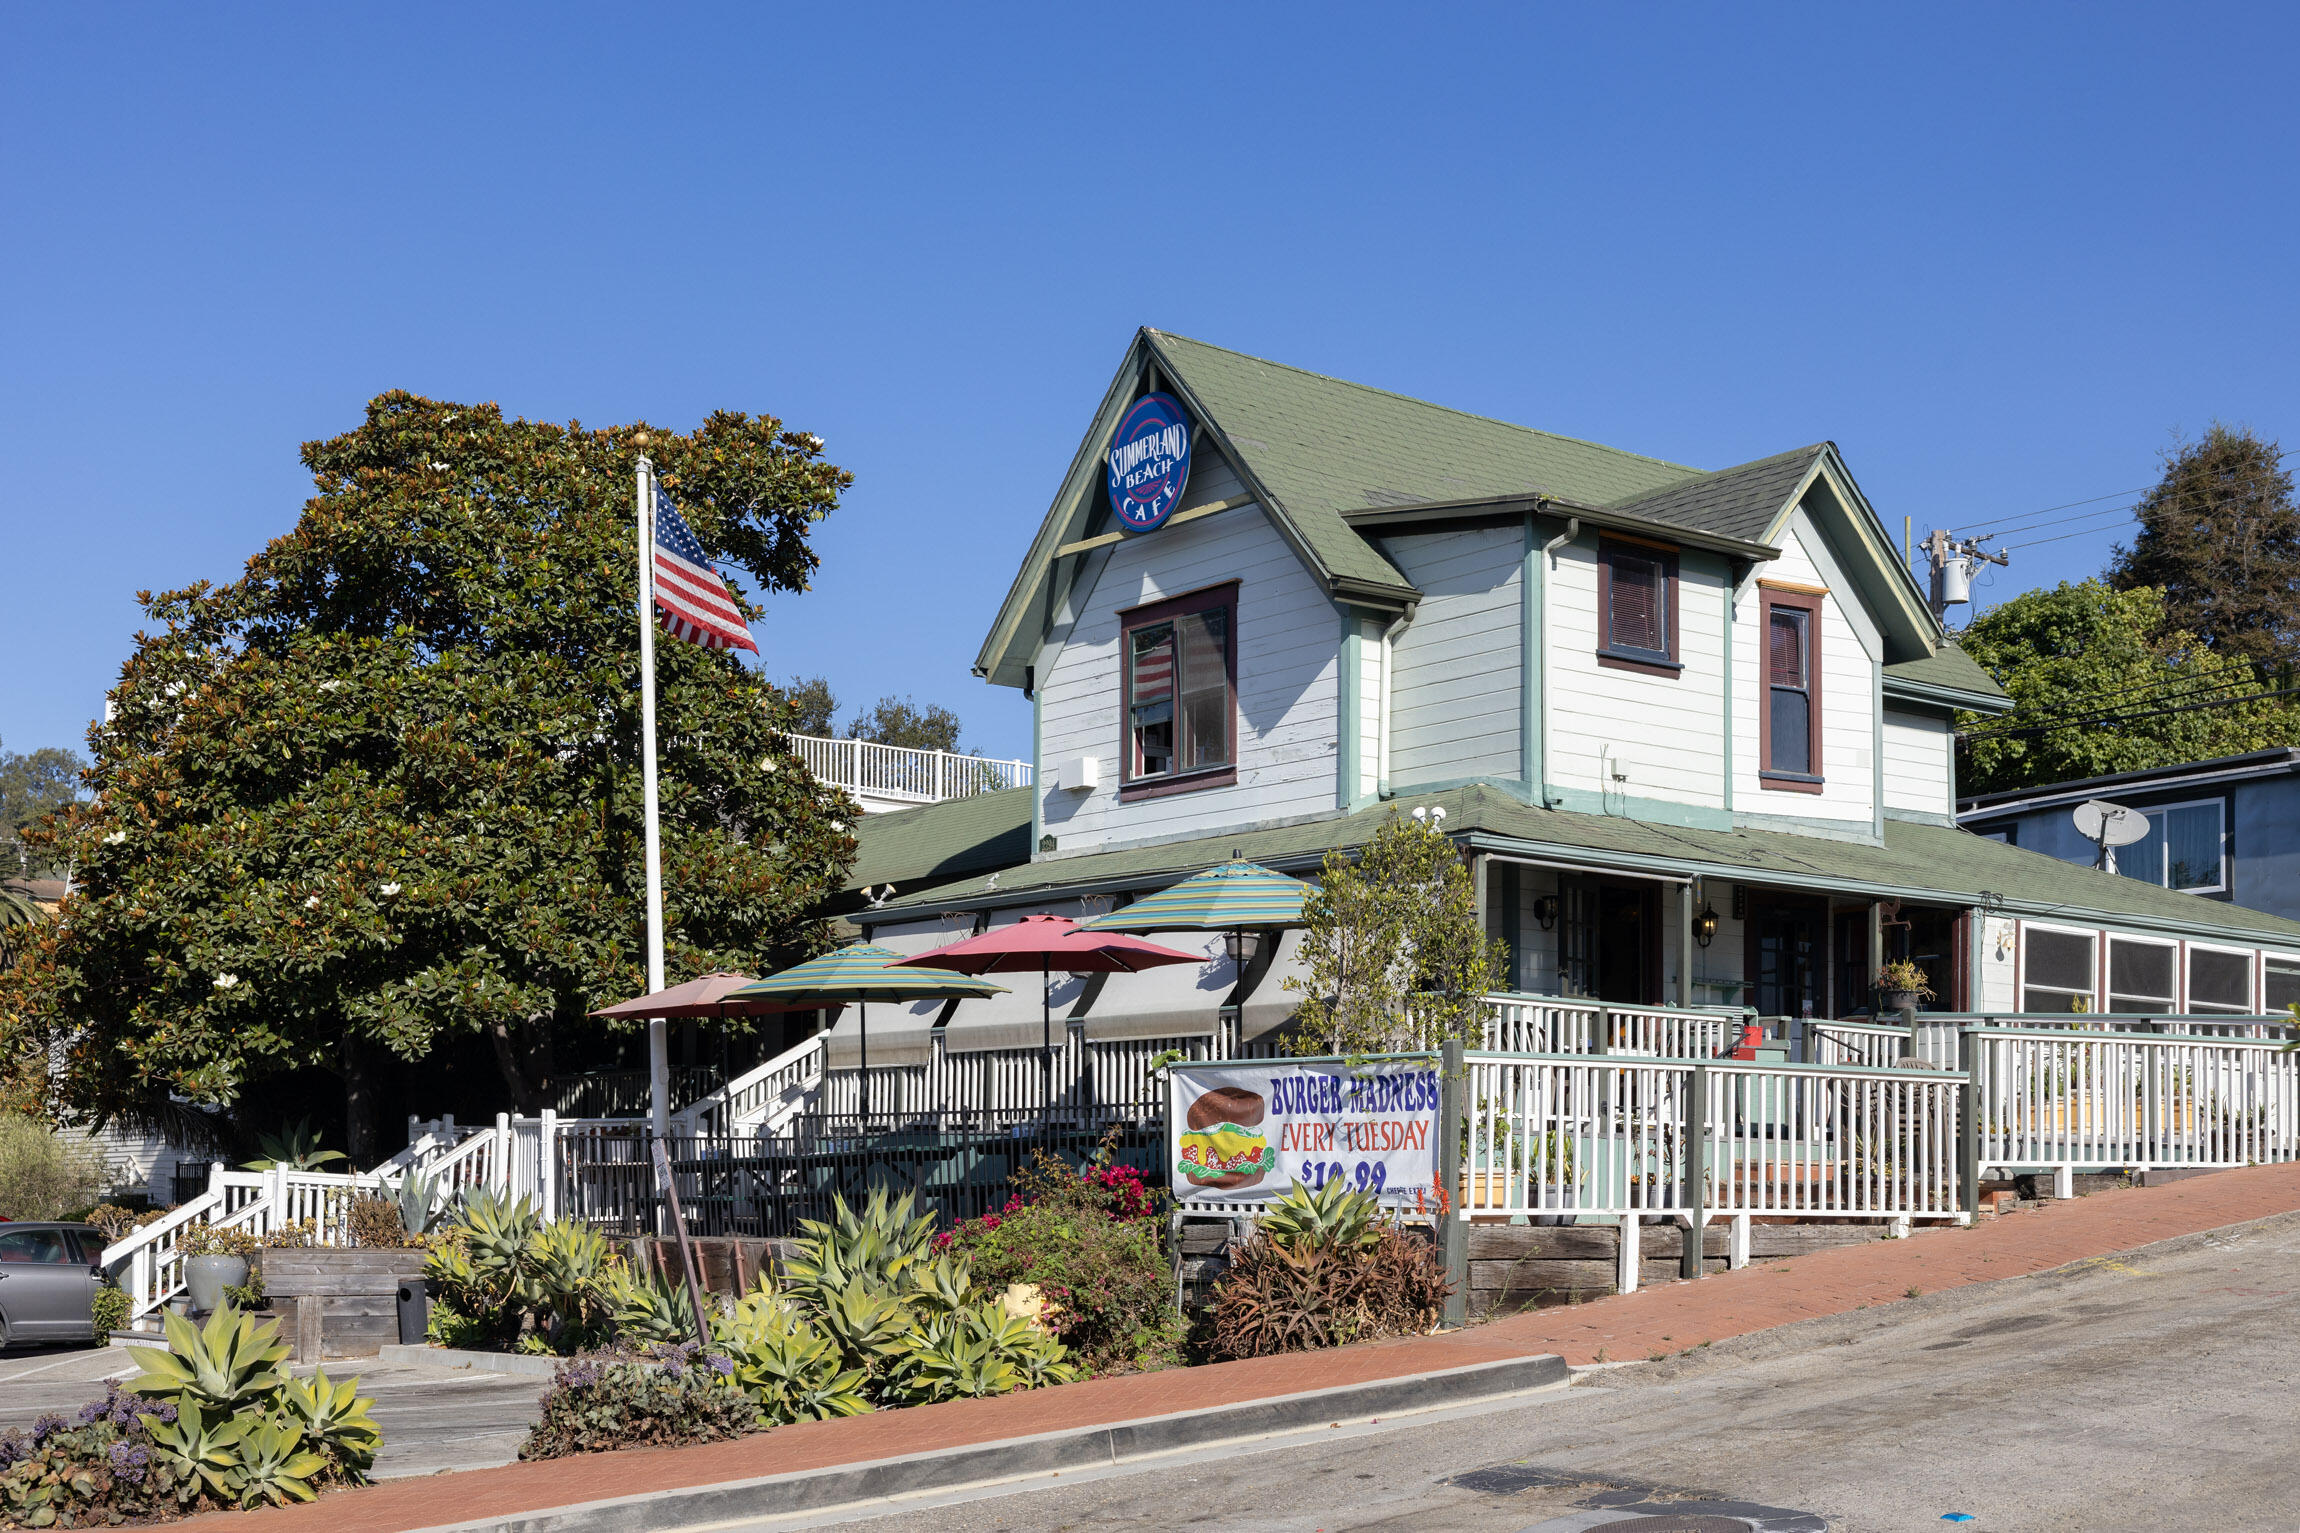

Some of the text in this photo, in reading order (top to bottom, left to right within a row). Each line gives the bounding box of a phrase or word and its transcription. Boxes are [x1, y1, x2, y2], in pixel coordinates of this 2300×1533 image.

[1110, 423, 1187, 488] SUMMERLAND
[1125, 458, 1174, 489] BEACH
[1123, 480, 1176, 521] CAFE
[1270, 1070, 1438, 1115] BURGER MADNESS
[1280, 1120, 1429, 1152] EVERY TUESDAY
